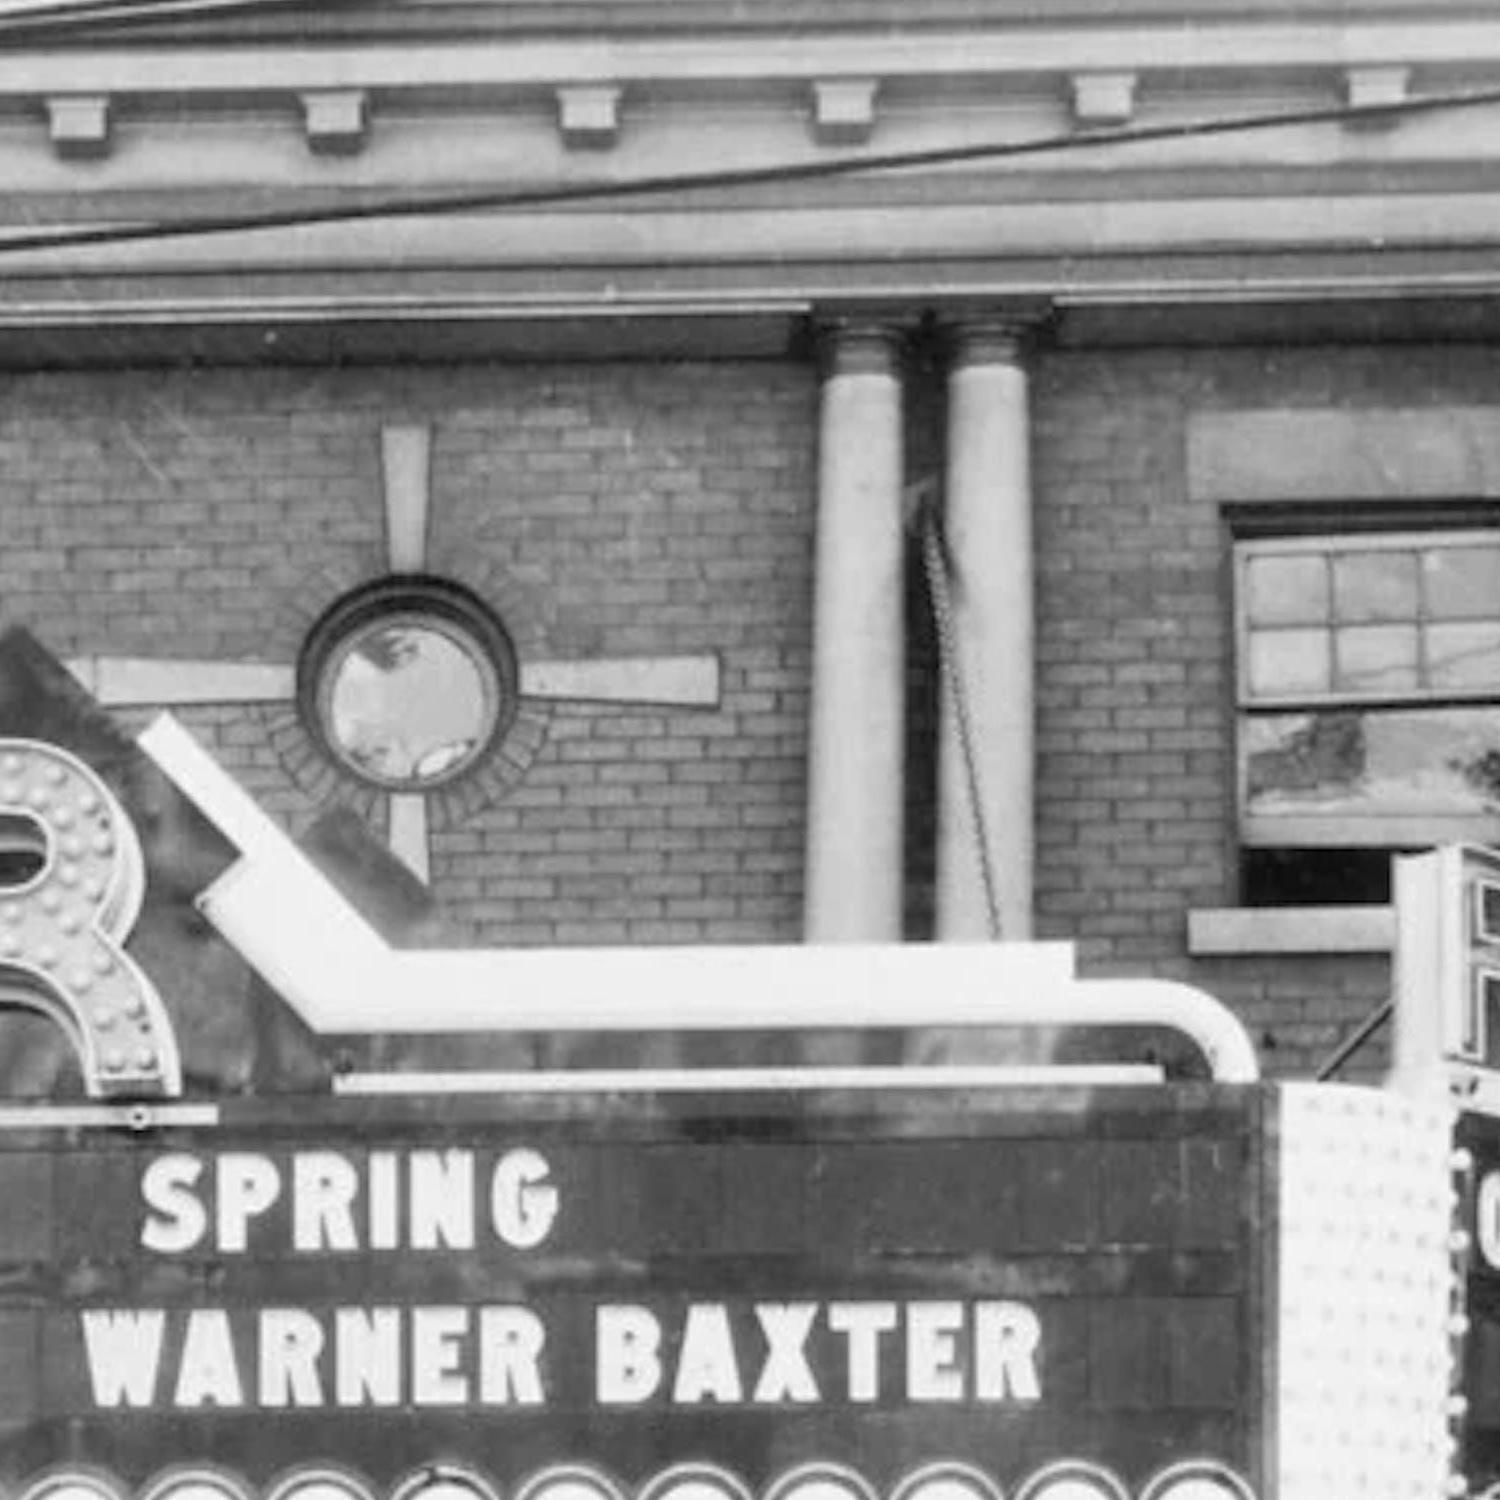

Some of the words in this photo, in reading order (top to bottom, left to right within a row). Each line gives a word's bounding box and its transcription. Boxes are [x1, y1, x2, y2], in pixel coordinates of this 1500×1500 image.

[141, 1148, 559, 1252] SPRING
[82, 1305, 545, 1408] WARNER
[596, 1300, 1042, 1404] BAXTER
